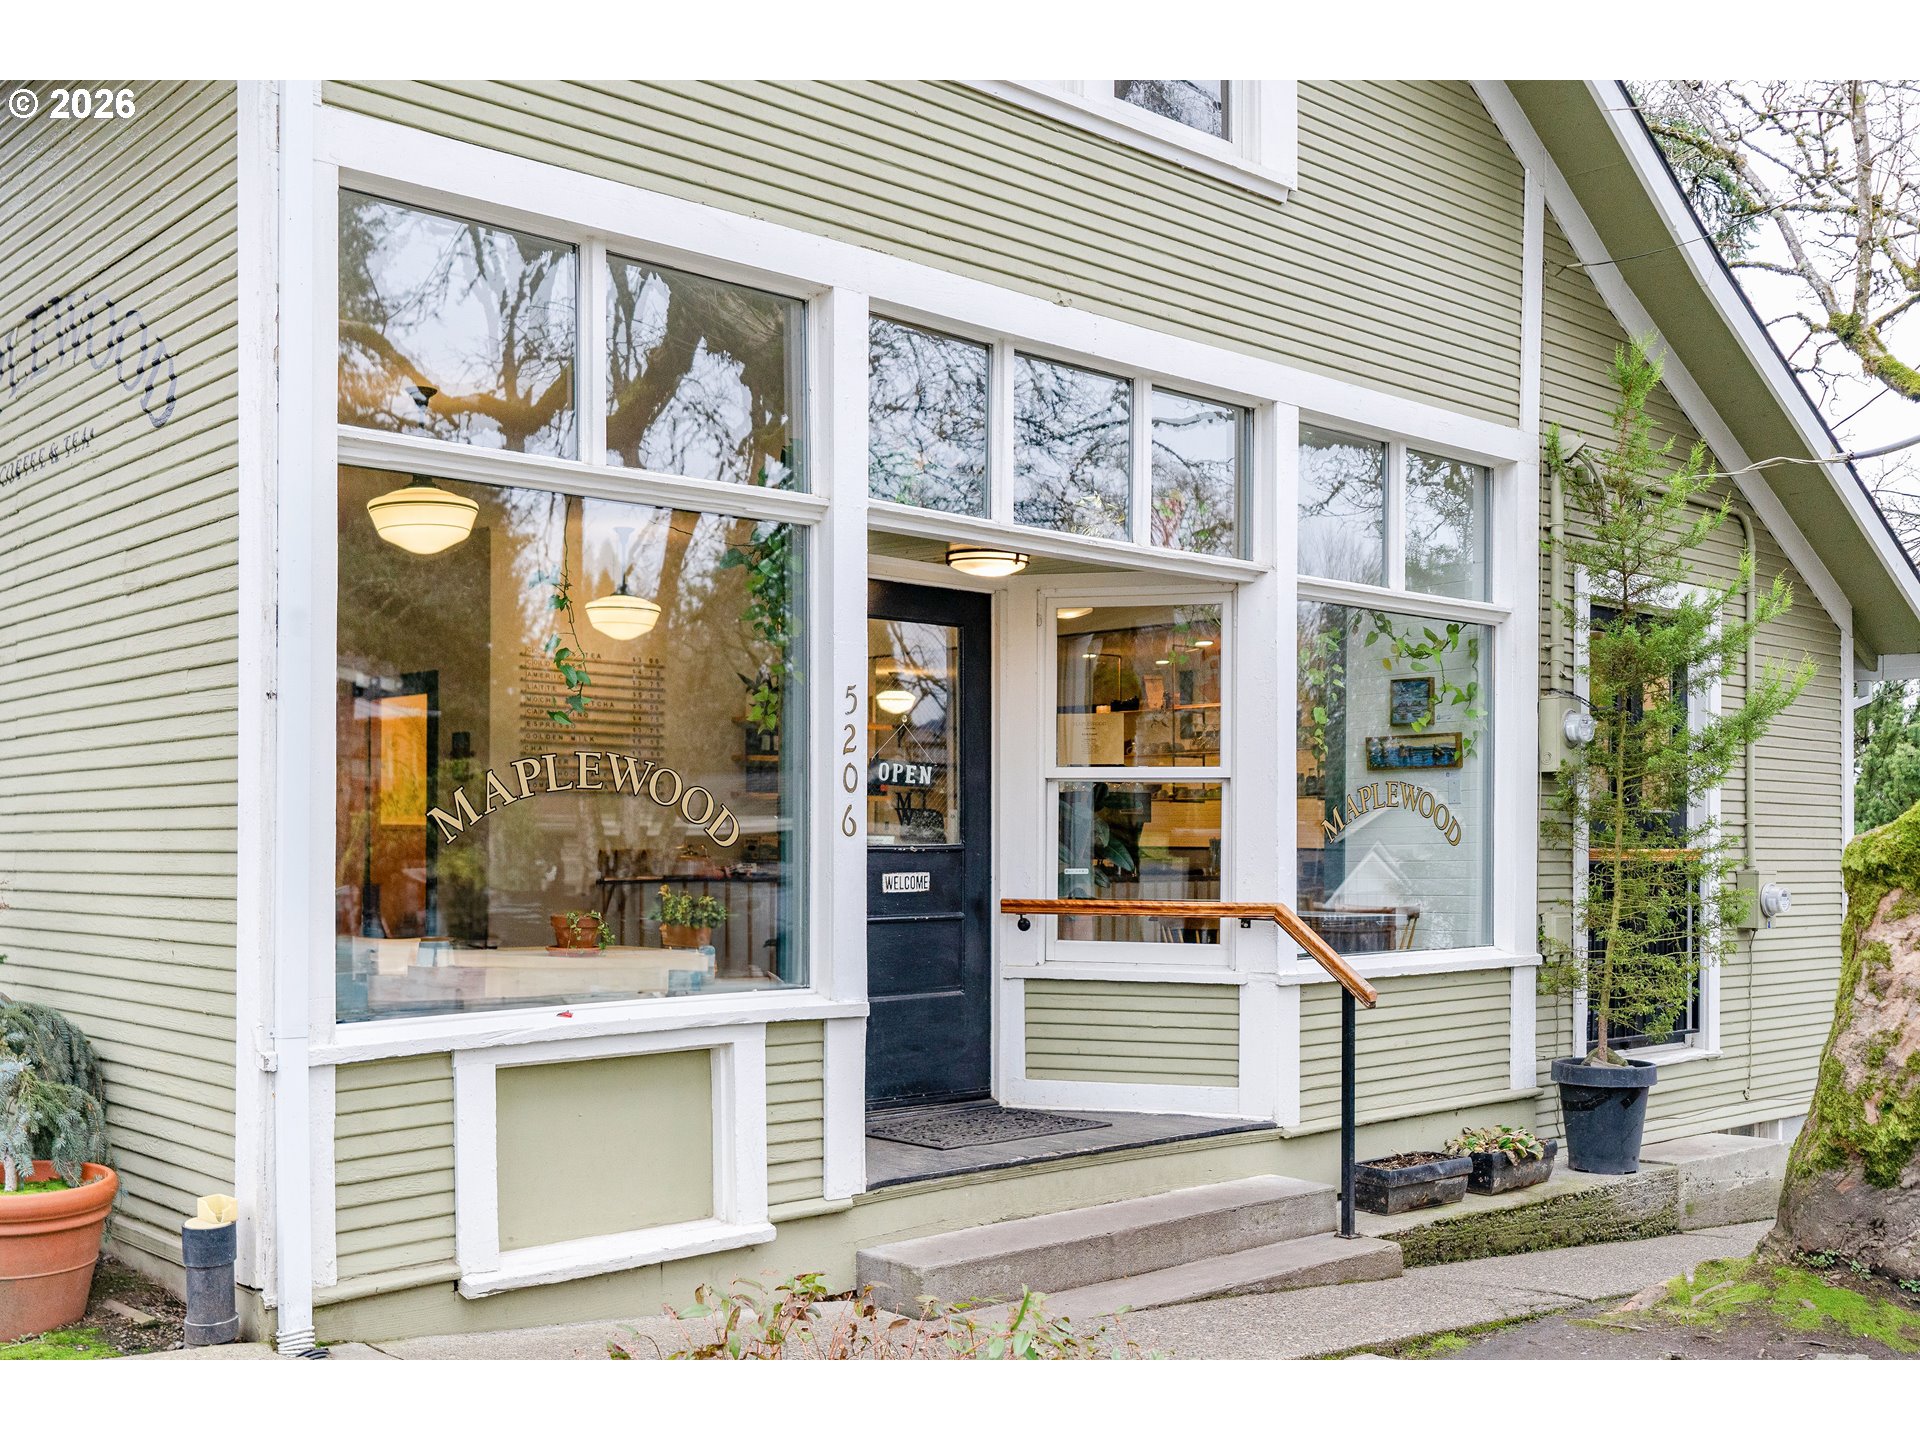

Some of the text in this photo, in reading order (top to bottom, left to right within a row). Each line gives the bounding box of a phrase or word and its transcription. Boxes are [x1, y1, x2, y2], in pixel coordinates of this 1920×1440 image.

[0, 291, 177, 428] LEWOOD
[63, 427, 95, 458] TEA
[526, 708, 589, 718] CAPINO
[525, 732, 564, 740] GOLDEN
[842, 684, 858, 837] 5206
[878, 762, 933, 786] OPEN
[427, 751, 741, 848] MAPLEWOOD
[1321, 780, 1462, 847] MAPLEWOOD
[884, 874, 929, 891] WELCOME
